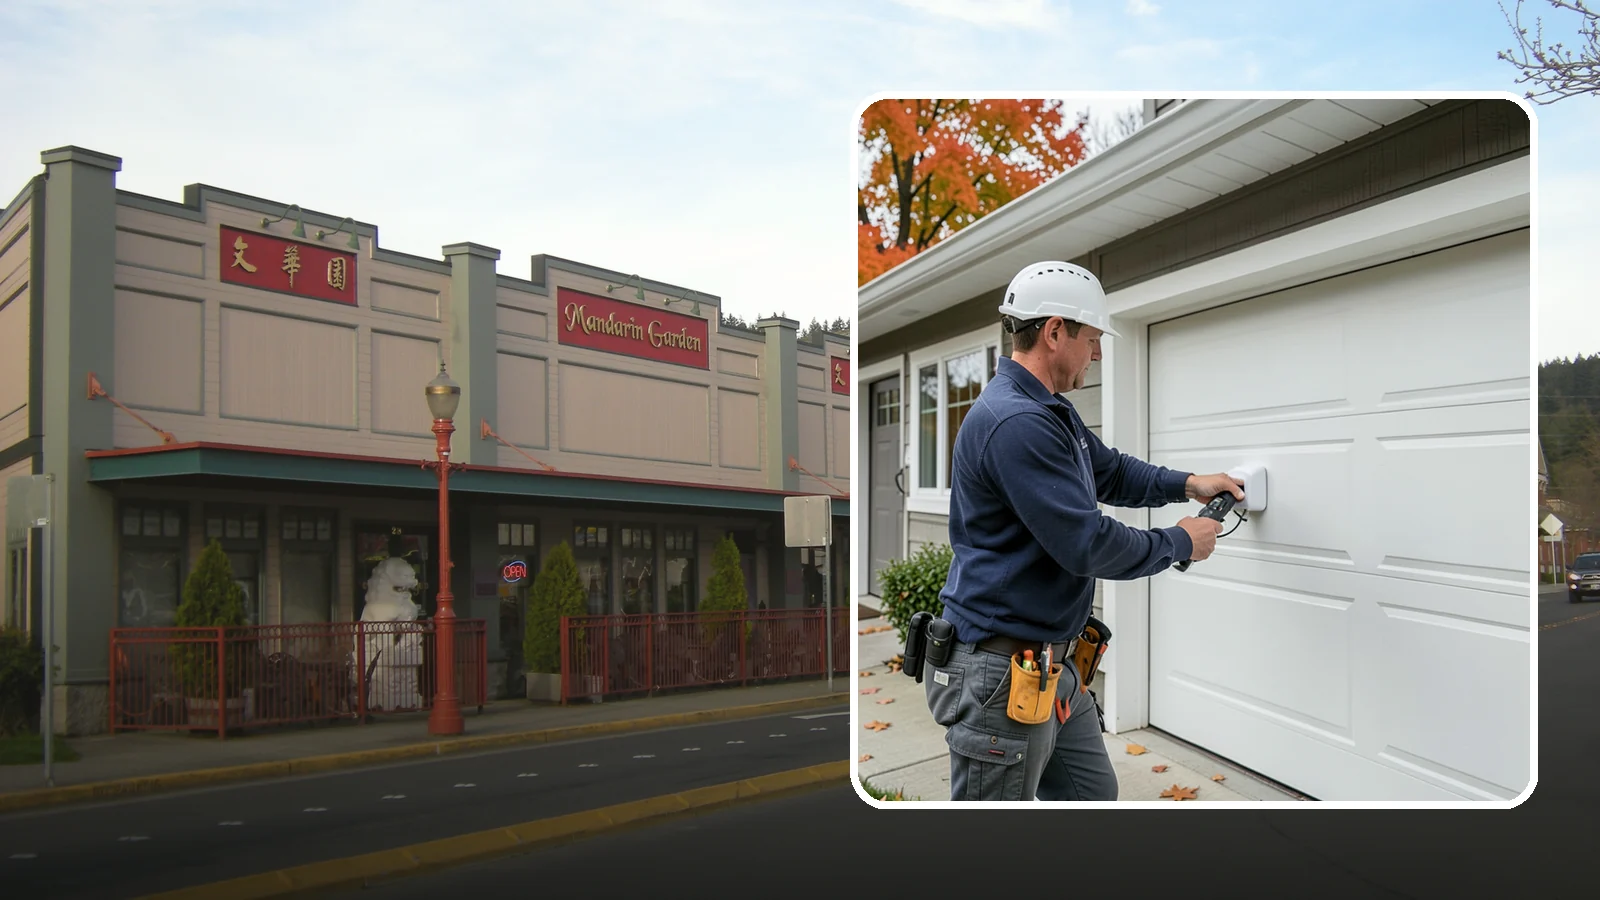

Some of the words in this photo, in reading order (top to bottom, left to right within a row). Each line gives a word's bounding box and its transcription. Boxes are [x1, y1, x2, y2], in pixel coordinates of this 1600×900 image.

[231, 236, 346, 290] 文華園
[564, 302, 644, 341] Mandarin
[648, 320, 701, 352] Garden
[503, 565, 527, 578] OPEN
